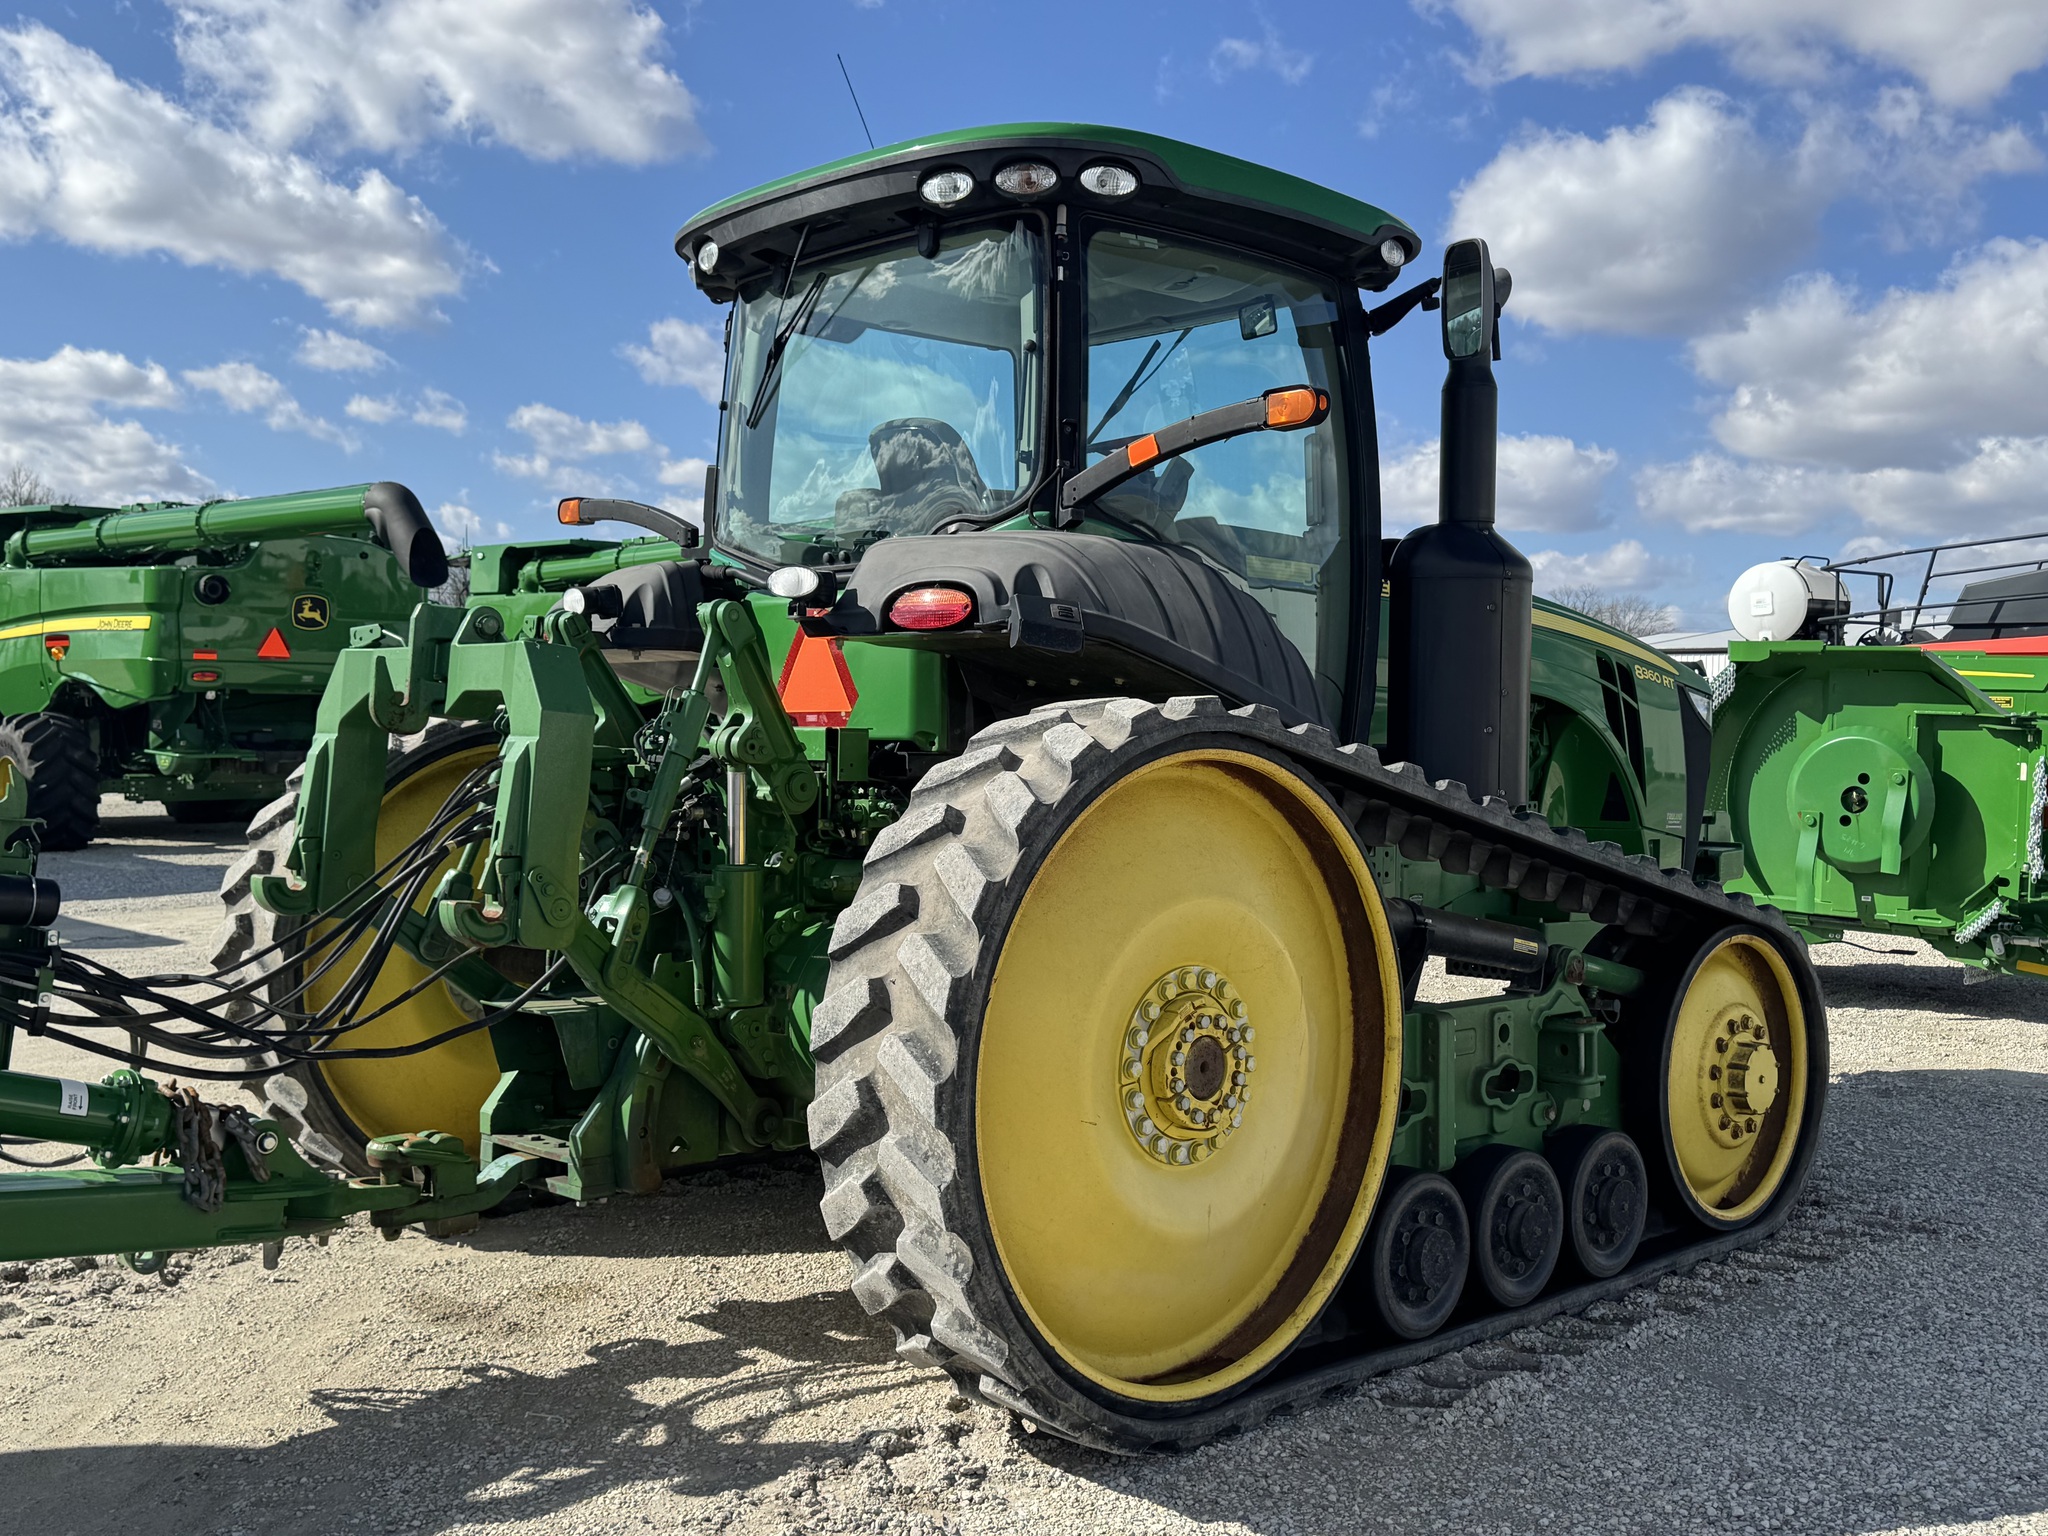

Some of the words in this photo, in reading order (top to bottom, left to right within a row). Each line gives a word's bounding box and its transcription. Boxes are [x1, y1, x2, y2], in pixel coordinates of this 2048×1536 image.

[97, 618, 113, 629] JOHN
[113, 618, 133, 629] DEERE
[1634, 664, 1662, 684] 8360
[1662, 674, 1675, 690] RT
